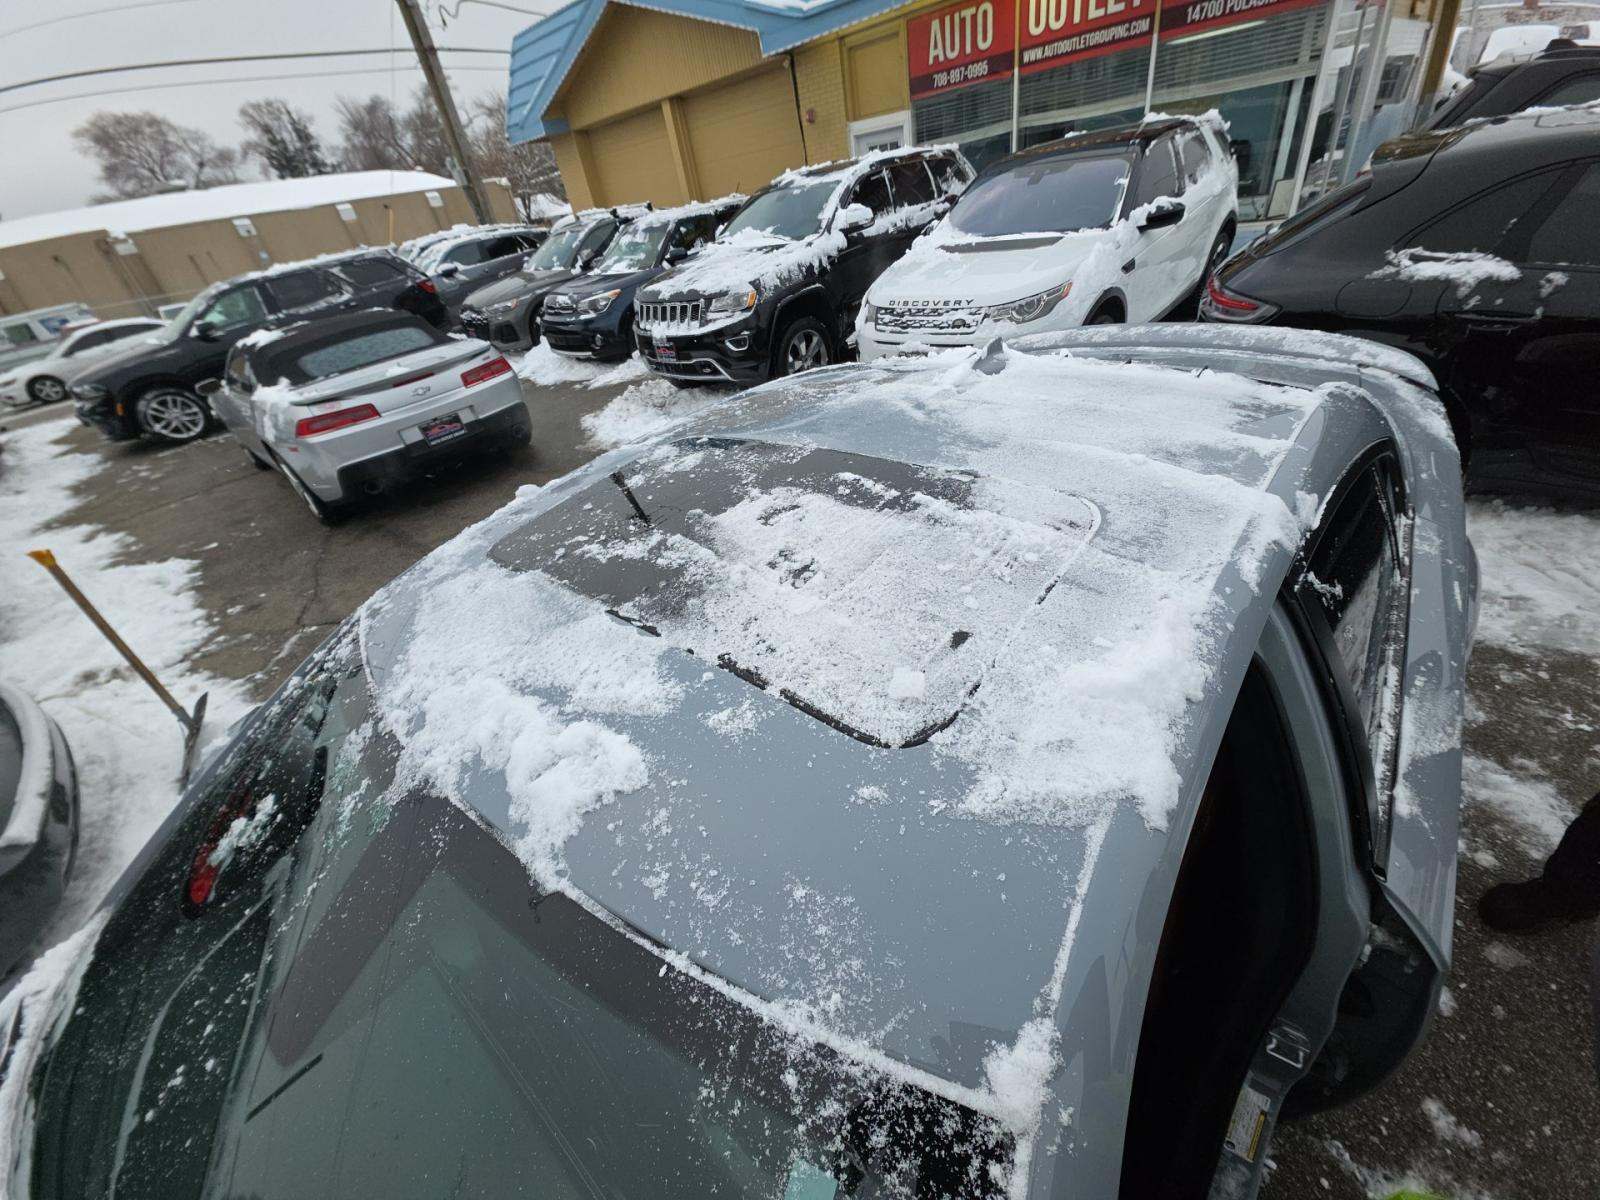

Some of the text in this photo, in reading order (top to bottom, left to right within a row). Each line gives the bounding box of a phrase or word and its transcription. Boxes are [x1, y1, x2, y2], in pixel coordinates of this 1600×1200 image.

[928, 0, 1140, 66] AUTO OUT
[1023, 17, 1150, 64] WWW.AUTOOUTLETGROUPINC.COM
[1186, 1, 1223, 24] 14700
[889, 299, 974, 307] DISCOVERY
